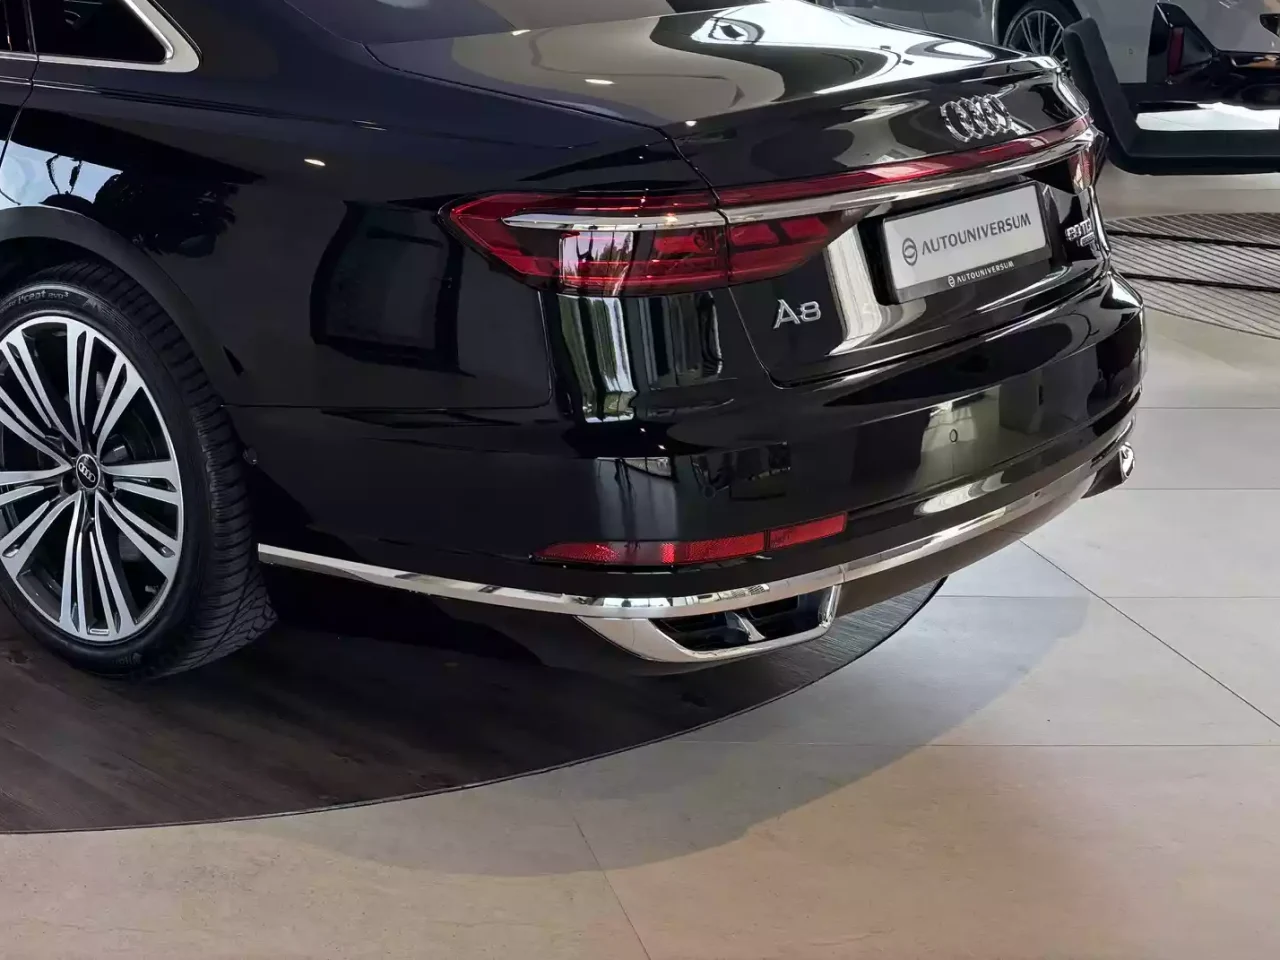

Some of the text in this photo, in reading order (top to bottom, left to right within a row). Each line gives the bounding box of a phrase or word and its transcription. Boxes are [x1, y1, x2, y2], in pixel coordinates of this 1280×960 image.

[922, 213, 1031, 255] AUTOUNIVERSUM
[957, 260, 1015, 283] AUTOUNIVERSUM
[773, 299, 821, 329] A8
